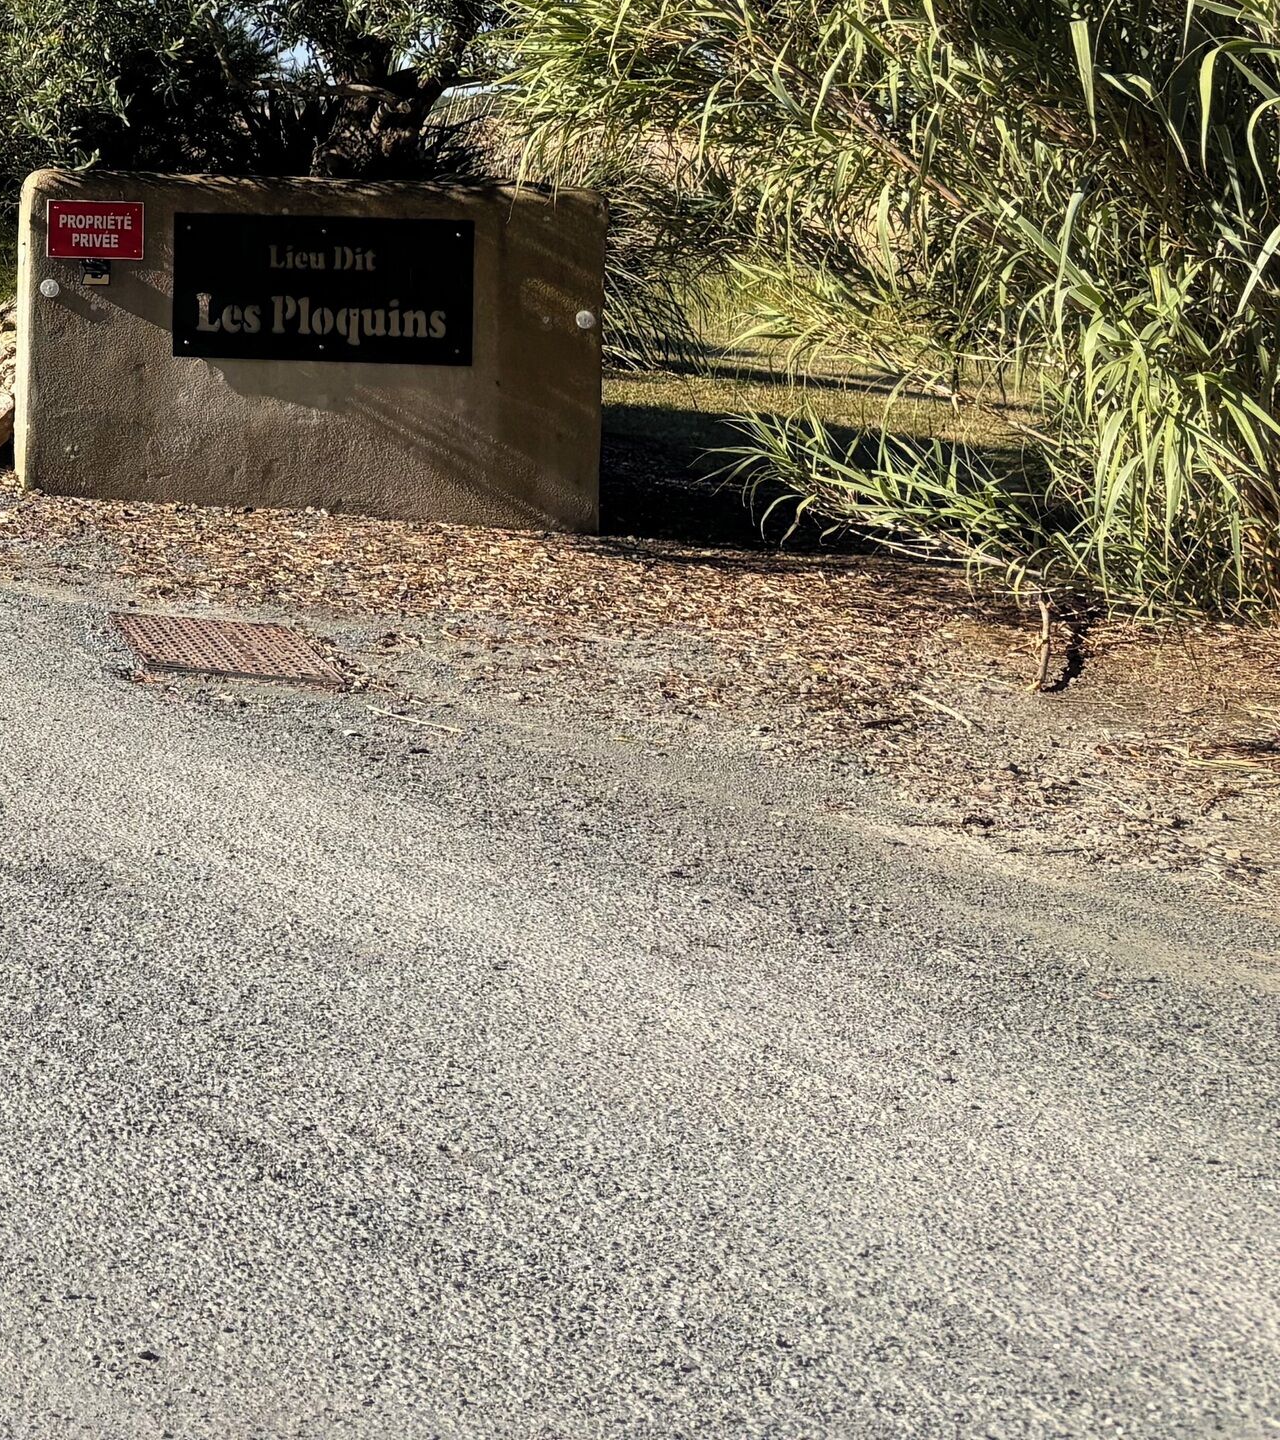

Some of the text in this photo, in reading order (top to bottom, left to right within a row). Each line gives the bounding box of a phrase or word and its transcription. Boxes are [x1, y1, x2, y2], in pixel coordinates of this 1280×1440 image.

[59, 212, 132, 230] PROPRIÉTÉ
[72, 230, 119, 248] PRIVÉE
[269, 244, 377, 271] Lieu Dit
[196, 292, 447, 346] Les Ploquins
